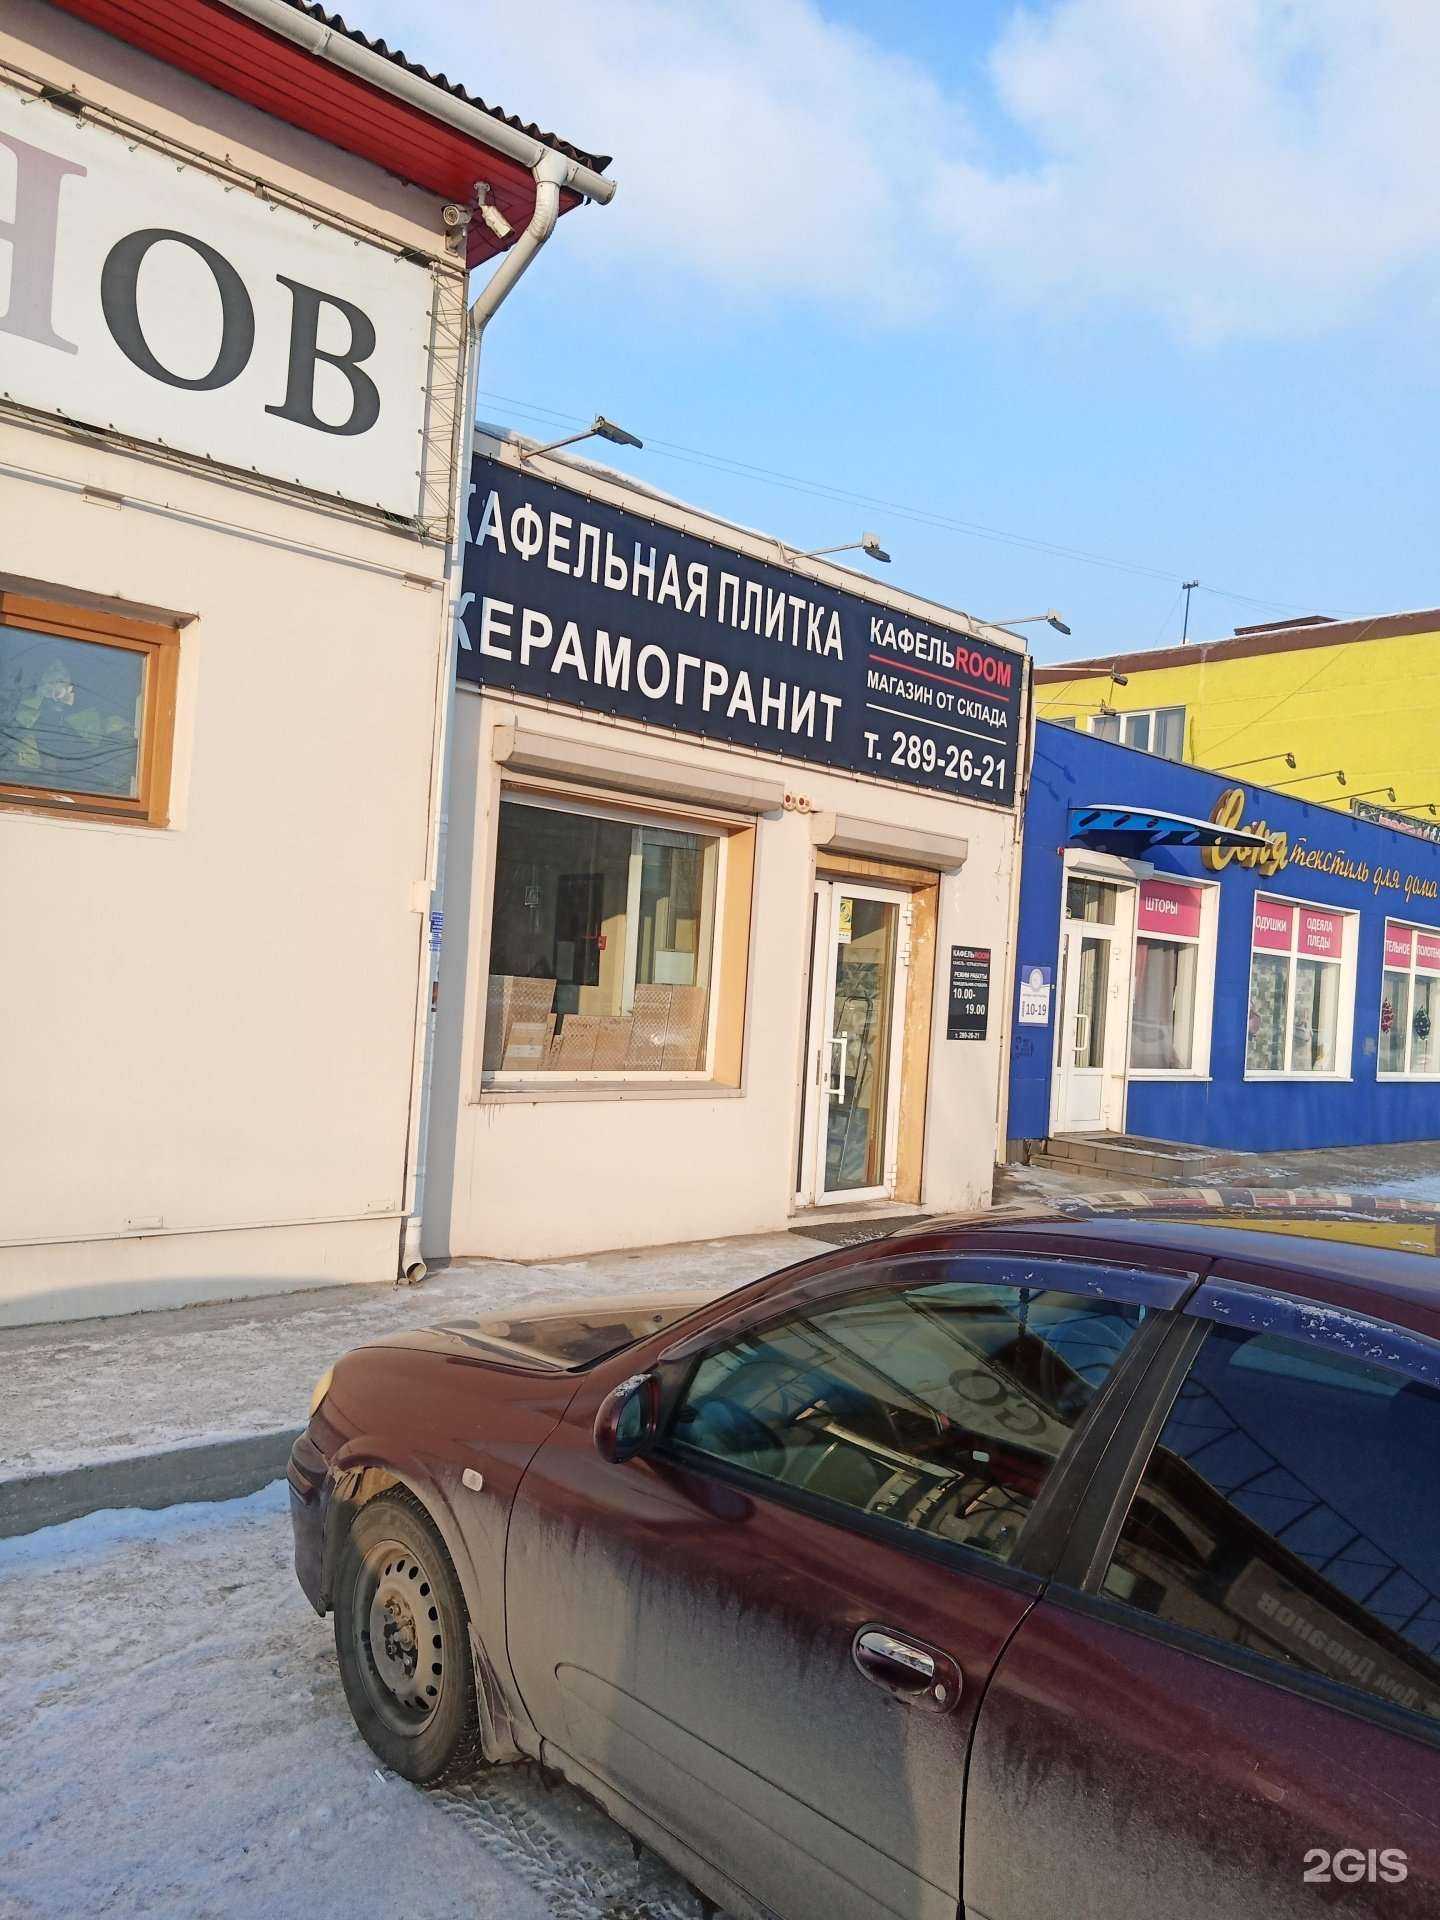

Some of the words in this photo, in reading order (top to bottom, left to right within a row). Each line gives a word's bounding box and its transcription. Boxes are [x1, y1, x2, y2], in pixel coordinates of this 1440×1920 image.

[718, 571, 844, 661] ПЛИТКА
[867, 670, 933, 706] МАГАЗИН
[936, 691, 955, 711] ОТ
[957, 698, 1008, 728] СКЛАДА
[890, 730, 1006, 790] 289-26-21
[1289, 837, 1370, 882] текстиль
[1373, 866, 1401, 896] для
[1145, 896, 1178, 916] ШТОРЫ
[1306, 916, 1334, 934] ОДЕЯЛА
[1306, 933, 1331, 950] ПЛЕДЫ
[953, 988, 976, 999] 10.00-
[965, 1003, 986, 1016] 19.00
[1025, 1002, 1047, 1017] 10-19
